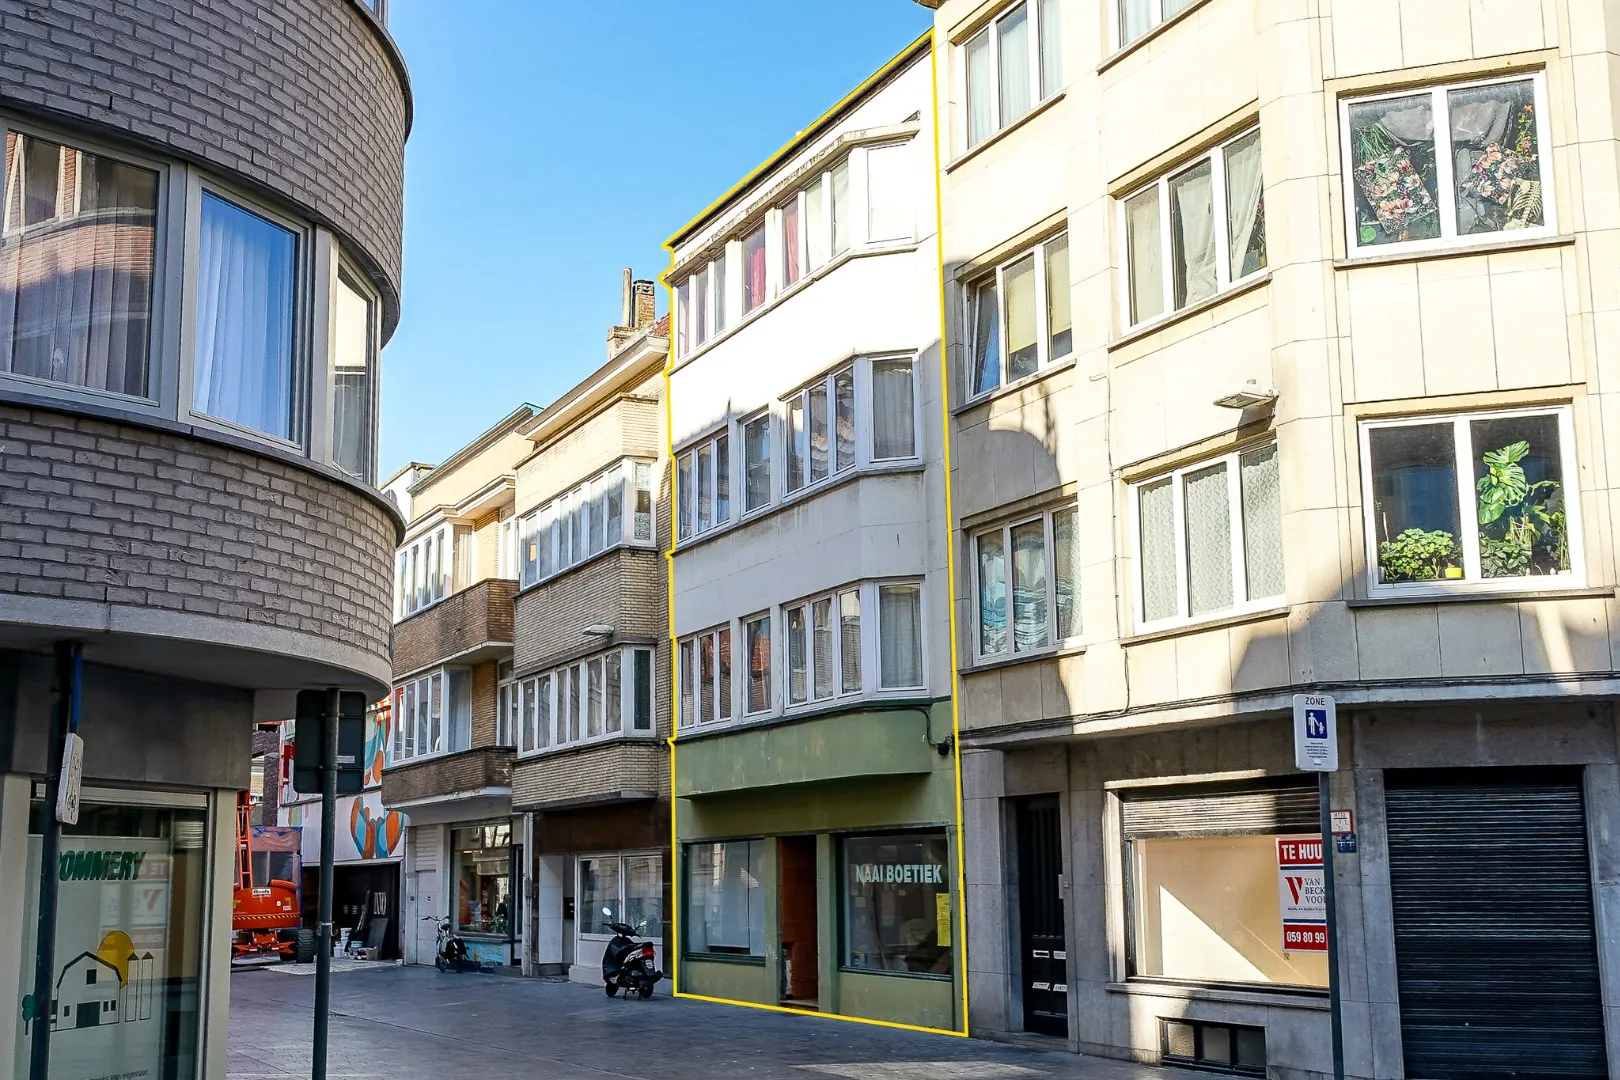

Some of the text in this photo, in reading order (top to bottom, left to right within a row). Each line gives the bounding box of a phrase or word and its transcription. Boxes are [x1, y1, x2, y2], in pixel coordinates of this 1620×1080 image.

[1305, 697, 1326, 706] ZONE
[1281, 844, 1296, 860] TE
[59, 850, 146, 881] OMMERY
[856, 864, 942, 883] NAAI BOETIEK
[1304, 878, 1320, 886] VAN
[1286, 931, 1325, 943] 059 80 99
